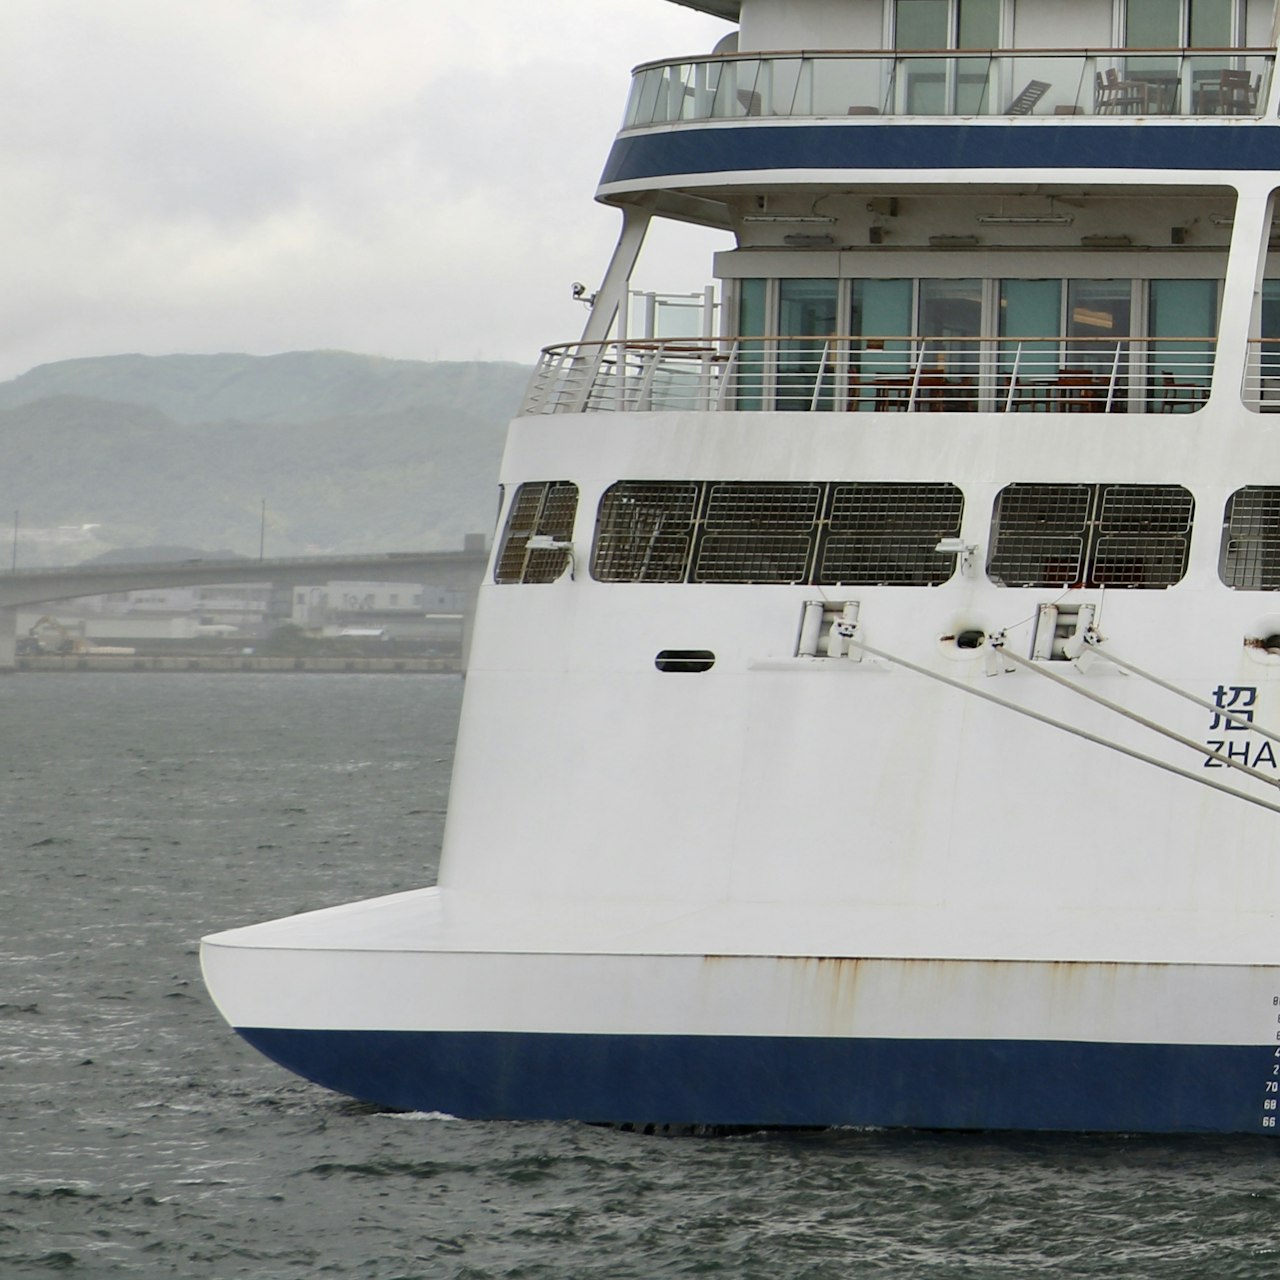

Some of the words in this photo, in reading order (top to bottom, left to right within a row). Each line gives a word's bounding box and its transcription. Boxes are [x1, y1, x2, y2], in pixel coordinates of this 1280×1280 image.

[1274, 1047, 1280, 1057] 4
[1273, 1065, 1280, 1075] 2
[1265, 1082, 1278, 1092] 70
[1264, 1099, 1276, 1110] 68
[1262, 1117, 1275, 1127] 66
